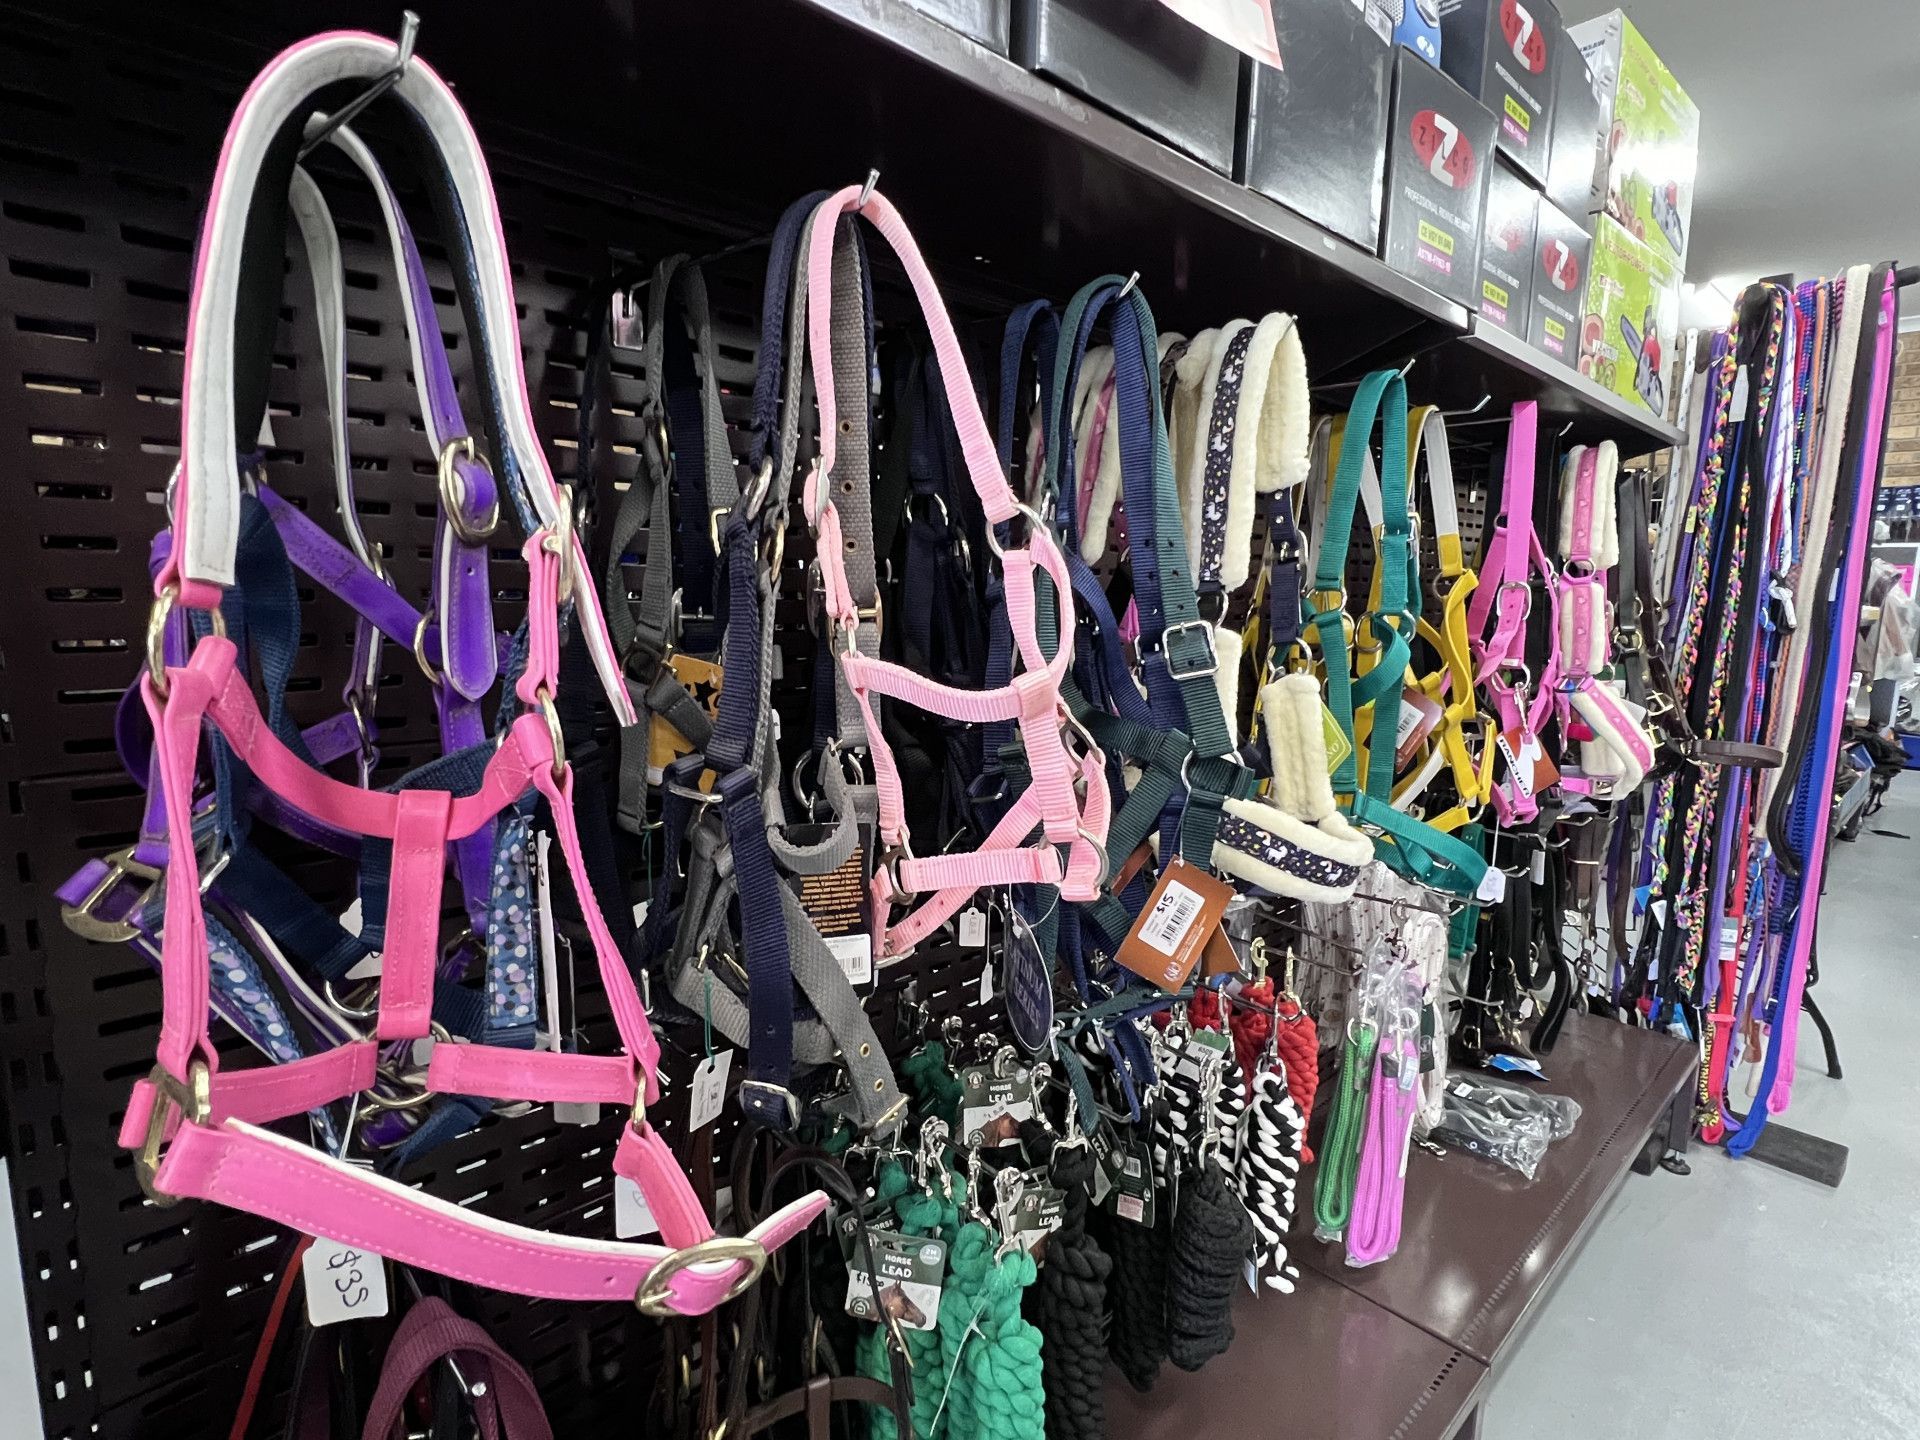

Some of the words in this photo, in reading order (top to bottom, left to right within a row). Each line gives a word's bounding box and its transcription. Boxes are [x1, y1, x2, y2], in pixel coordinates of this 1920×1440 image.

[1499, 738, 1530, 796] RANCHER
[1156, 893, 1174, 914] $15
[990, 1084, 1012, 1092] HORSE
[989, 1092, 1014, 1103] LEAD
[885, 1253, 912, 1266] HORSE
[881, 1263, 913, 1278] LEAD
[326, 1250, 368, 1308] $35
